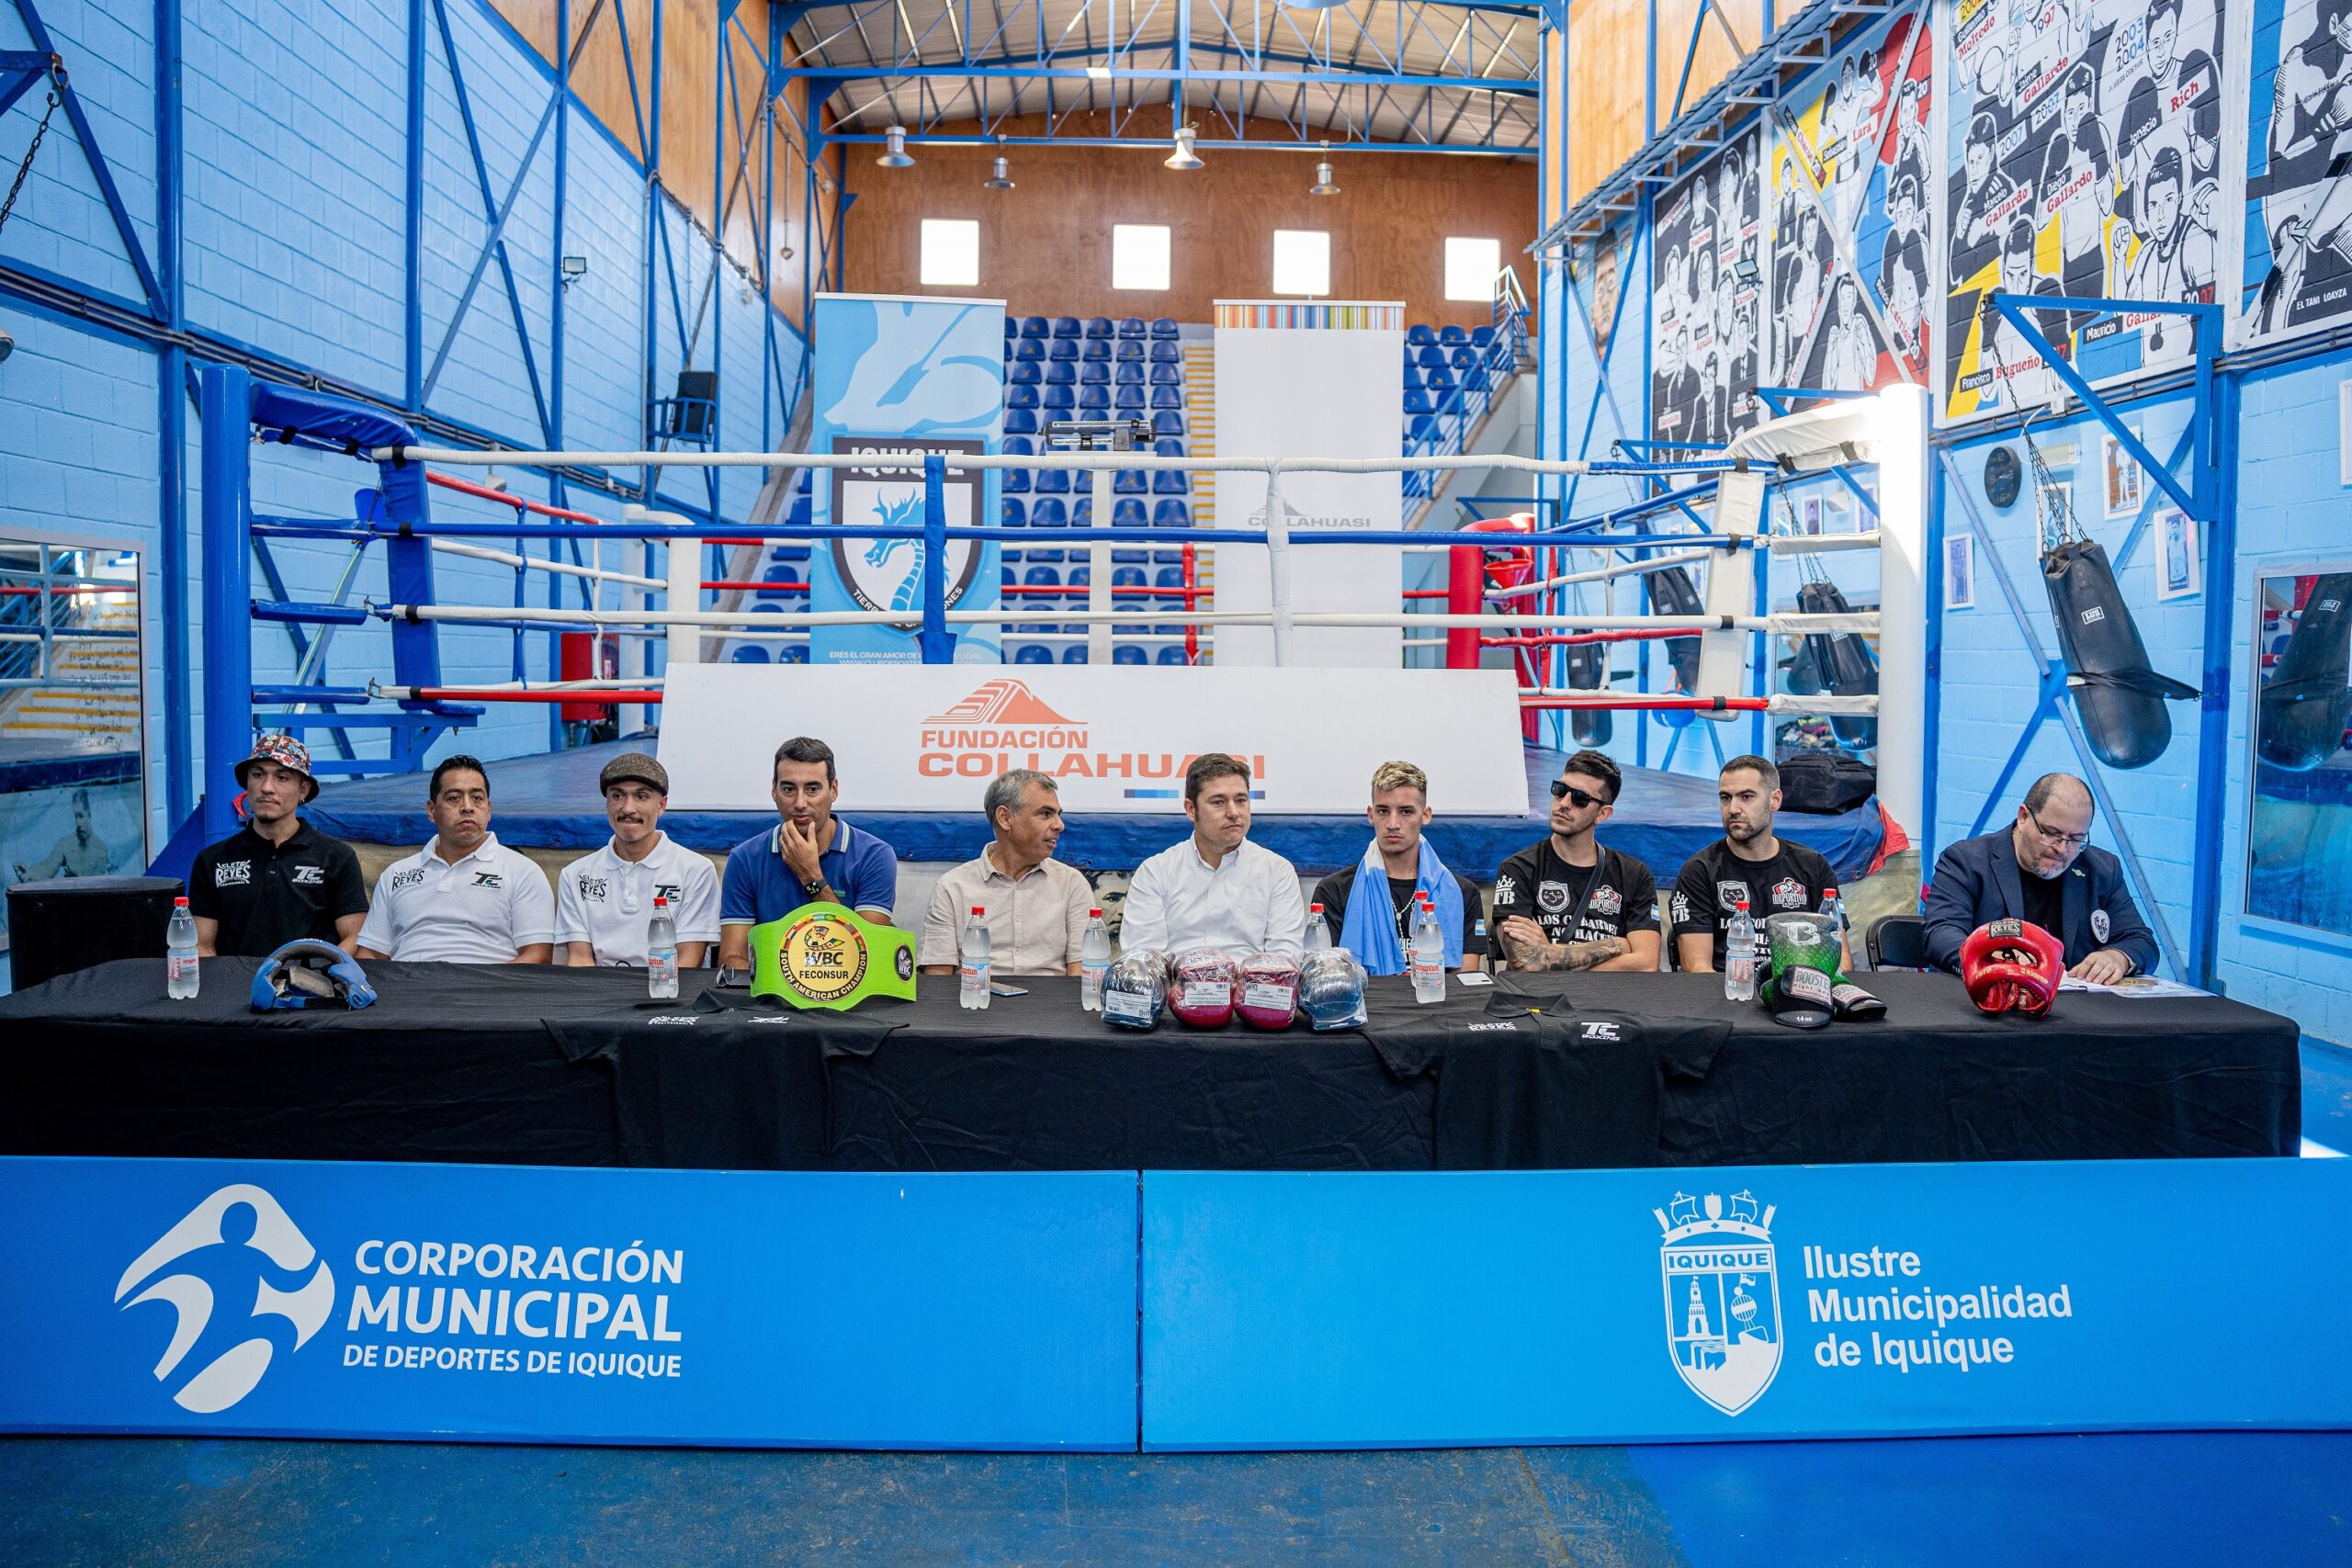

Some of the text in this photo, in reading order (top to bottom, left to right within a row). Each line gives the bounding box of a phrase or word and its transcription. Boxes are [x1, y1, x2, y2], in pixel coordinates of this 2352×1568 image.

[1958, 16, 1995, 60] Moltedo
[2035, 5, 2055, 39] 1997
[2115, 17, 2144, 53] 2003
[2115, 35, 2145, 72] 2004
[2024, 55, 2069, 103] Gallardo
[2035, 91, 2061, 125] 2007
[2170, 80, 2199, 113] Rich
[1999, 125, 2023, 157] 2007
[2130, 117, 2157, 146] Ignacio
[1984, 187, 2007, 212] Marcelo
[2046, 170, 2093, 213] Gallardo
[2047, 174, 2066, 195] Diego
[1985, 188, 2029, 227] Gallardo
[2296, 288, 2347, 310] EL TANI LOAYZA
[2086, 321, 2116, 342] Mauricio
[1962, 371, 1992, 389] Francisco
[860, 651, 881, 660] GRAN
[882, 651, 906, 660] AMOR
[906, 651, 917, 660] DE
[921, 727, 1088, 749] FUNDACIÓN
[216, 864, 251, 887] REYES
[391, 870, 425, 892] REYES
[1990, 923, 2020, 937] REYES
[805, 950, 843, 965] WBC
[780, 952, 867, 1000] SOUTH AMERICAN CHAMPION
[798, 970, 849, 979] FECONSUR
[1796, 971, 1829, 989] BOOSTE
[1580, 1021, 1620, 1037] TC
[355, 1240, 684, 1284] CORPORACIÓN
[1668, 1252, 1770, 1270] IQUIQUE
[1804, 1246, 1921, 1279] Ilustre
[345, 1285, 683, 1341] MUNICIPAL
[1807, 1284, 2073, 1328] Municipalidad
[343, 1345, 683, 1379] DE DEPORTES DE IQUIQUE
[1814, 1331, 2015, 1373] de Iquique
